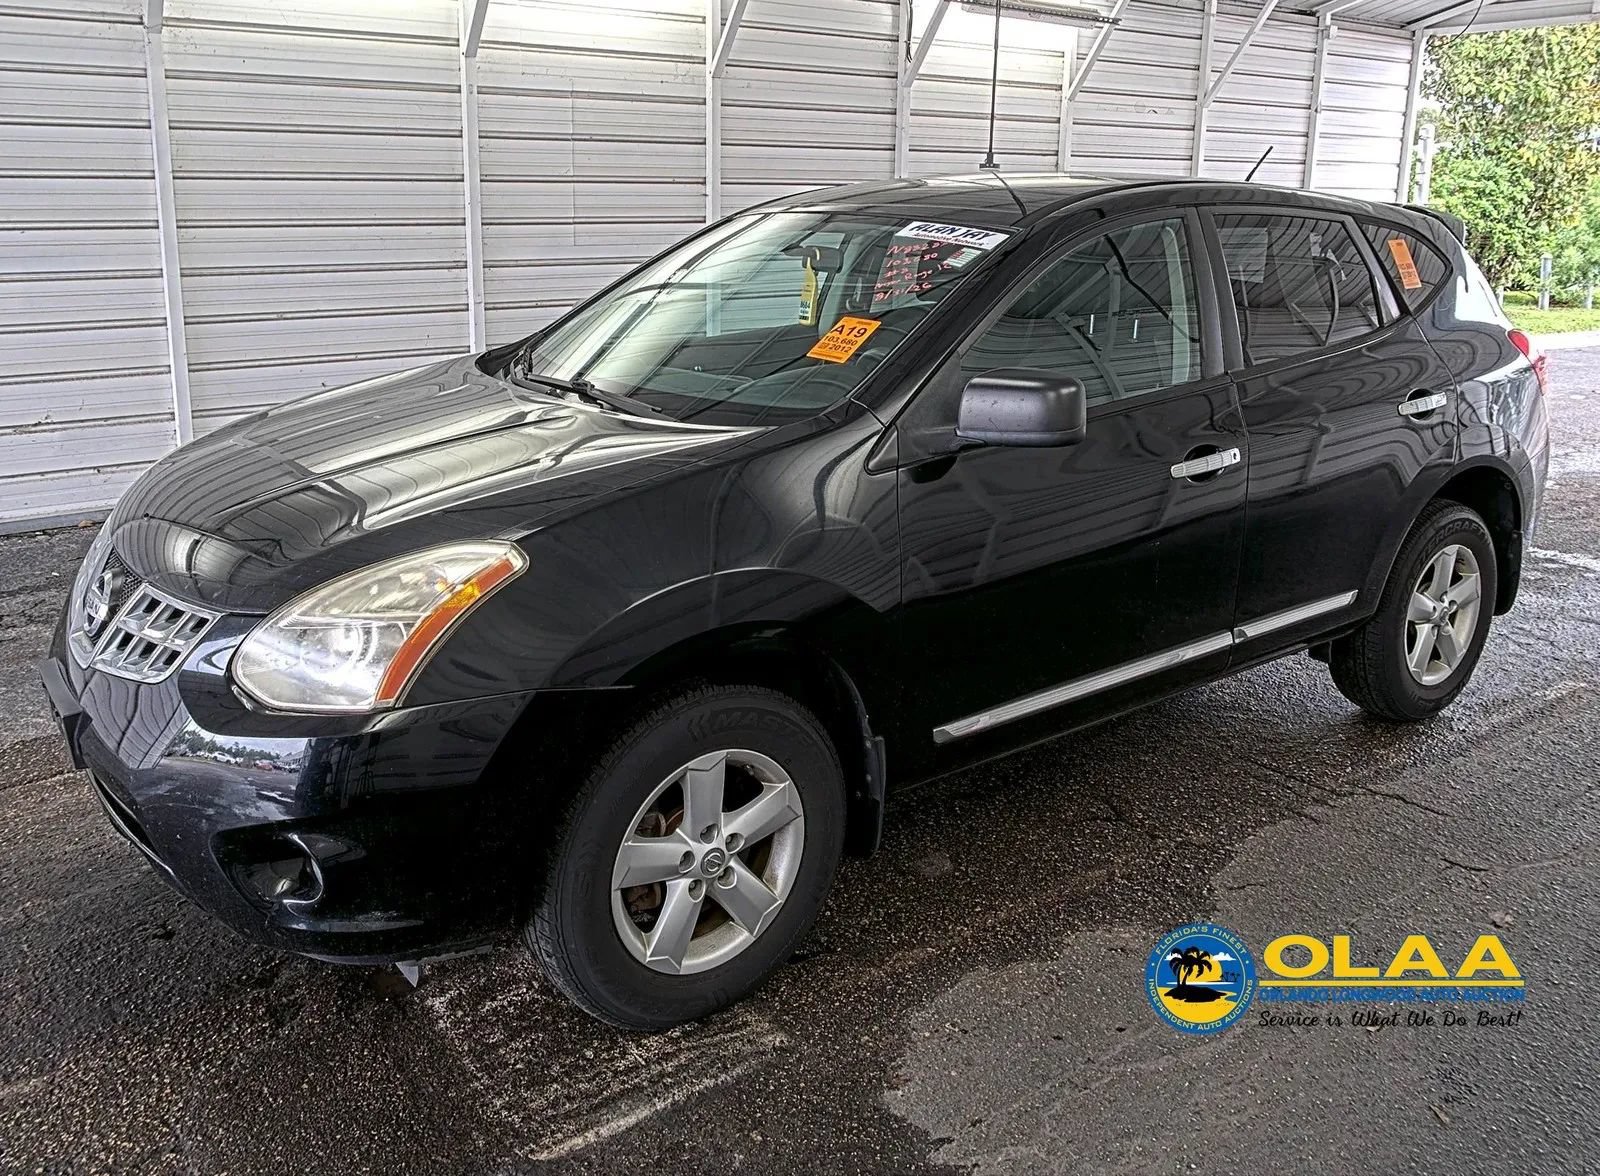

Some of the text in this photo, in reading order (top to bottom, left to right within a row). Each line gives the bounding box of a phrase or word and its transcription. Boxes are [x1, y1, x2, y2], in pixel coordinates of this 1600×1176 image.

[908, 223, 997, 241] ALAN JAY
[830, 323, 868, 339] A19
[824, 335, 859, 347] 103,680
[828, 343, 853, 354] 2012
